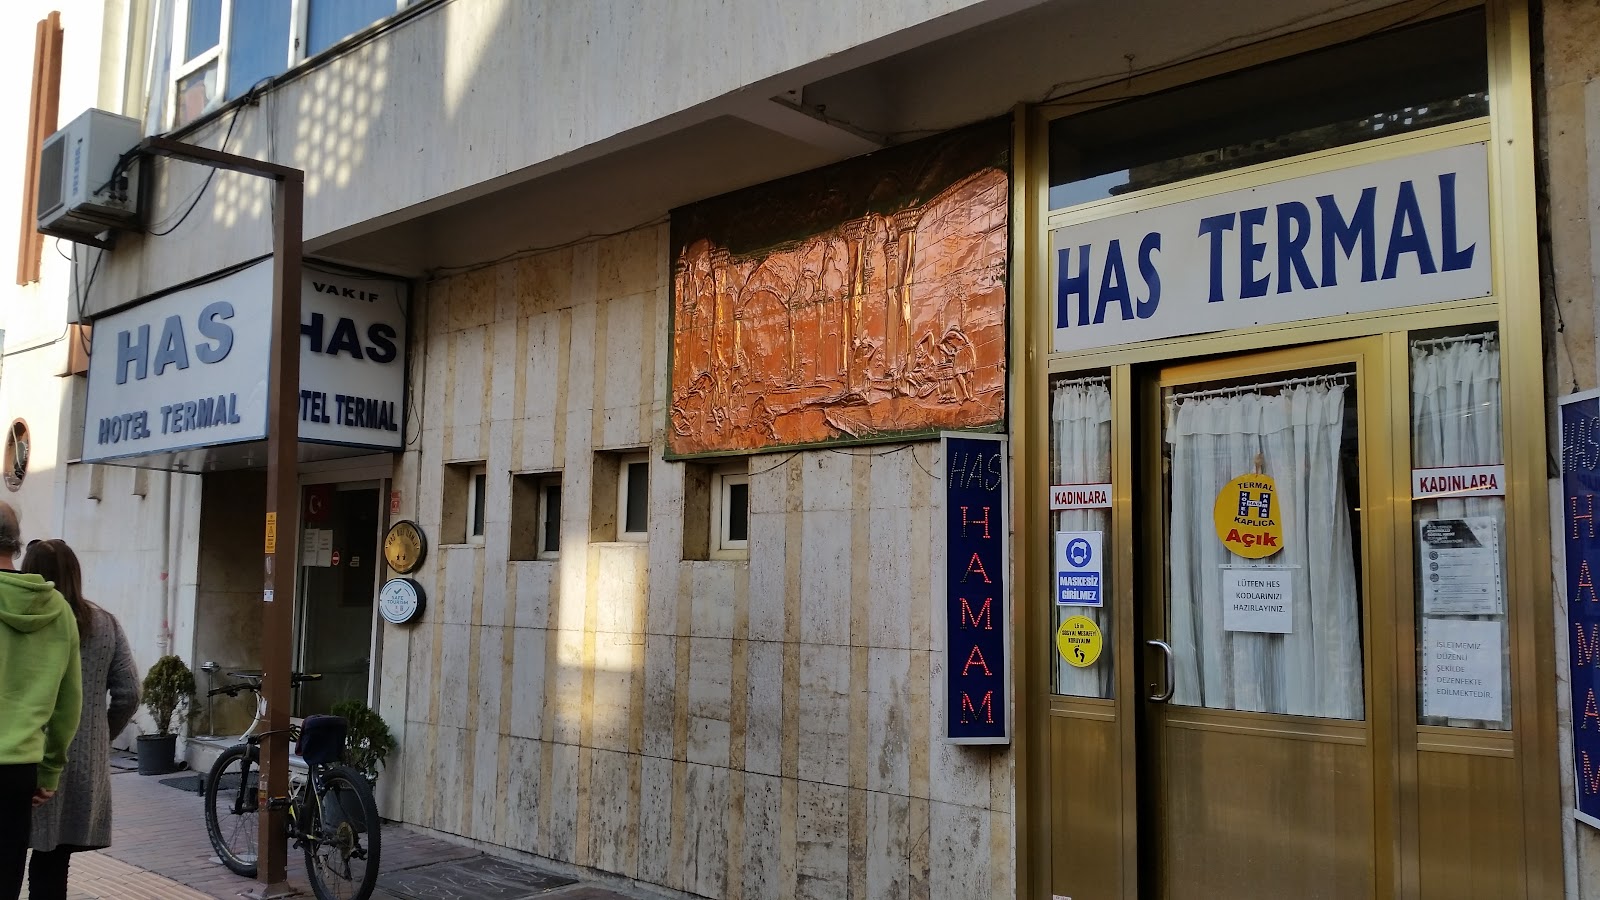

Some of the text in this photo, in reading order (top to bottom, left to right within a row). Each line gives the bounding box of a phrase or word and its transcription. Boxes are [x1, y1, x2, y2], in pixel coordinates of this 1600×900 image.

[1056, 172, 1476, 329] HAS TERMAL
[312, 281, 380, 303] VAKIF
[116, 301, 235, 385] HAS
[98, 392, 241, 445] HOTEL TERMAL
[300, 389, 398, 432] TEL TERMAL
[948, 451, 1002, 492] HAS
[1237, 482, 1274, 492] TERMAL
[1420, 473, 1499, 493] KADINLARA
[1054, 490, 1107, 505] KADINLARA
[1240, 492, 1248, 516] HOTEL
[1260, 493, 1269, 518] HAMAM
[1234, 516, 1275, 527] KAPLICA
[1225, 528, 1278, 548] Açık
[1060, 574, 1099, 587] MASKESİZ
[1237, 578, 1281, 588] LÜTFEN HES
[1062, 587, 1097, 600] GİRİLMEZ
[1235, 592, 1283, 600] KODLARINIZI
[959, 505, 994, 724] HAMAM
